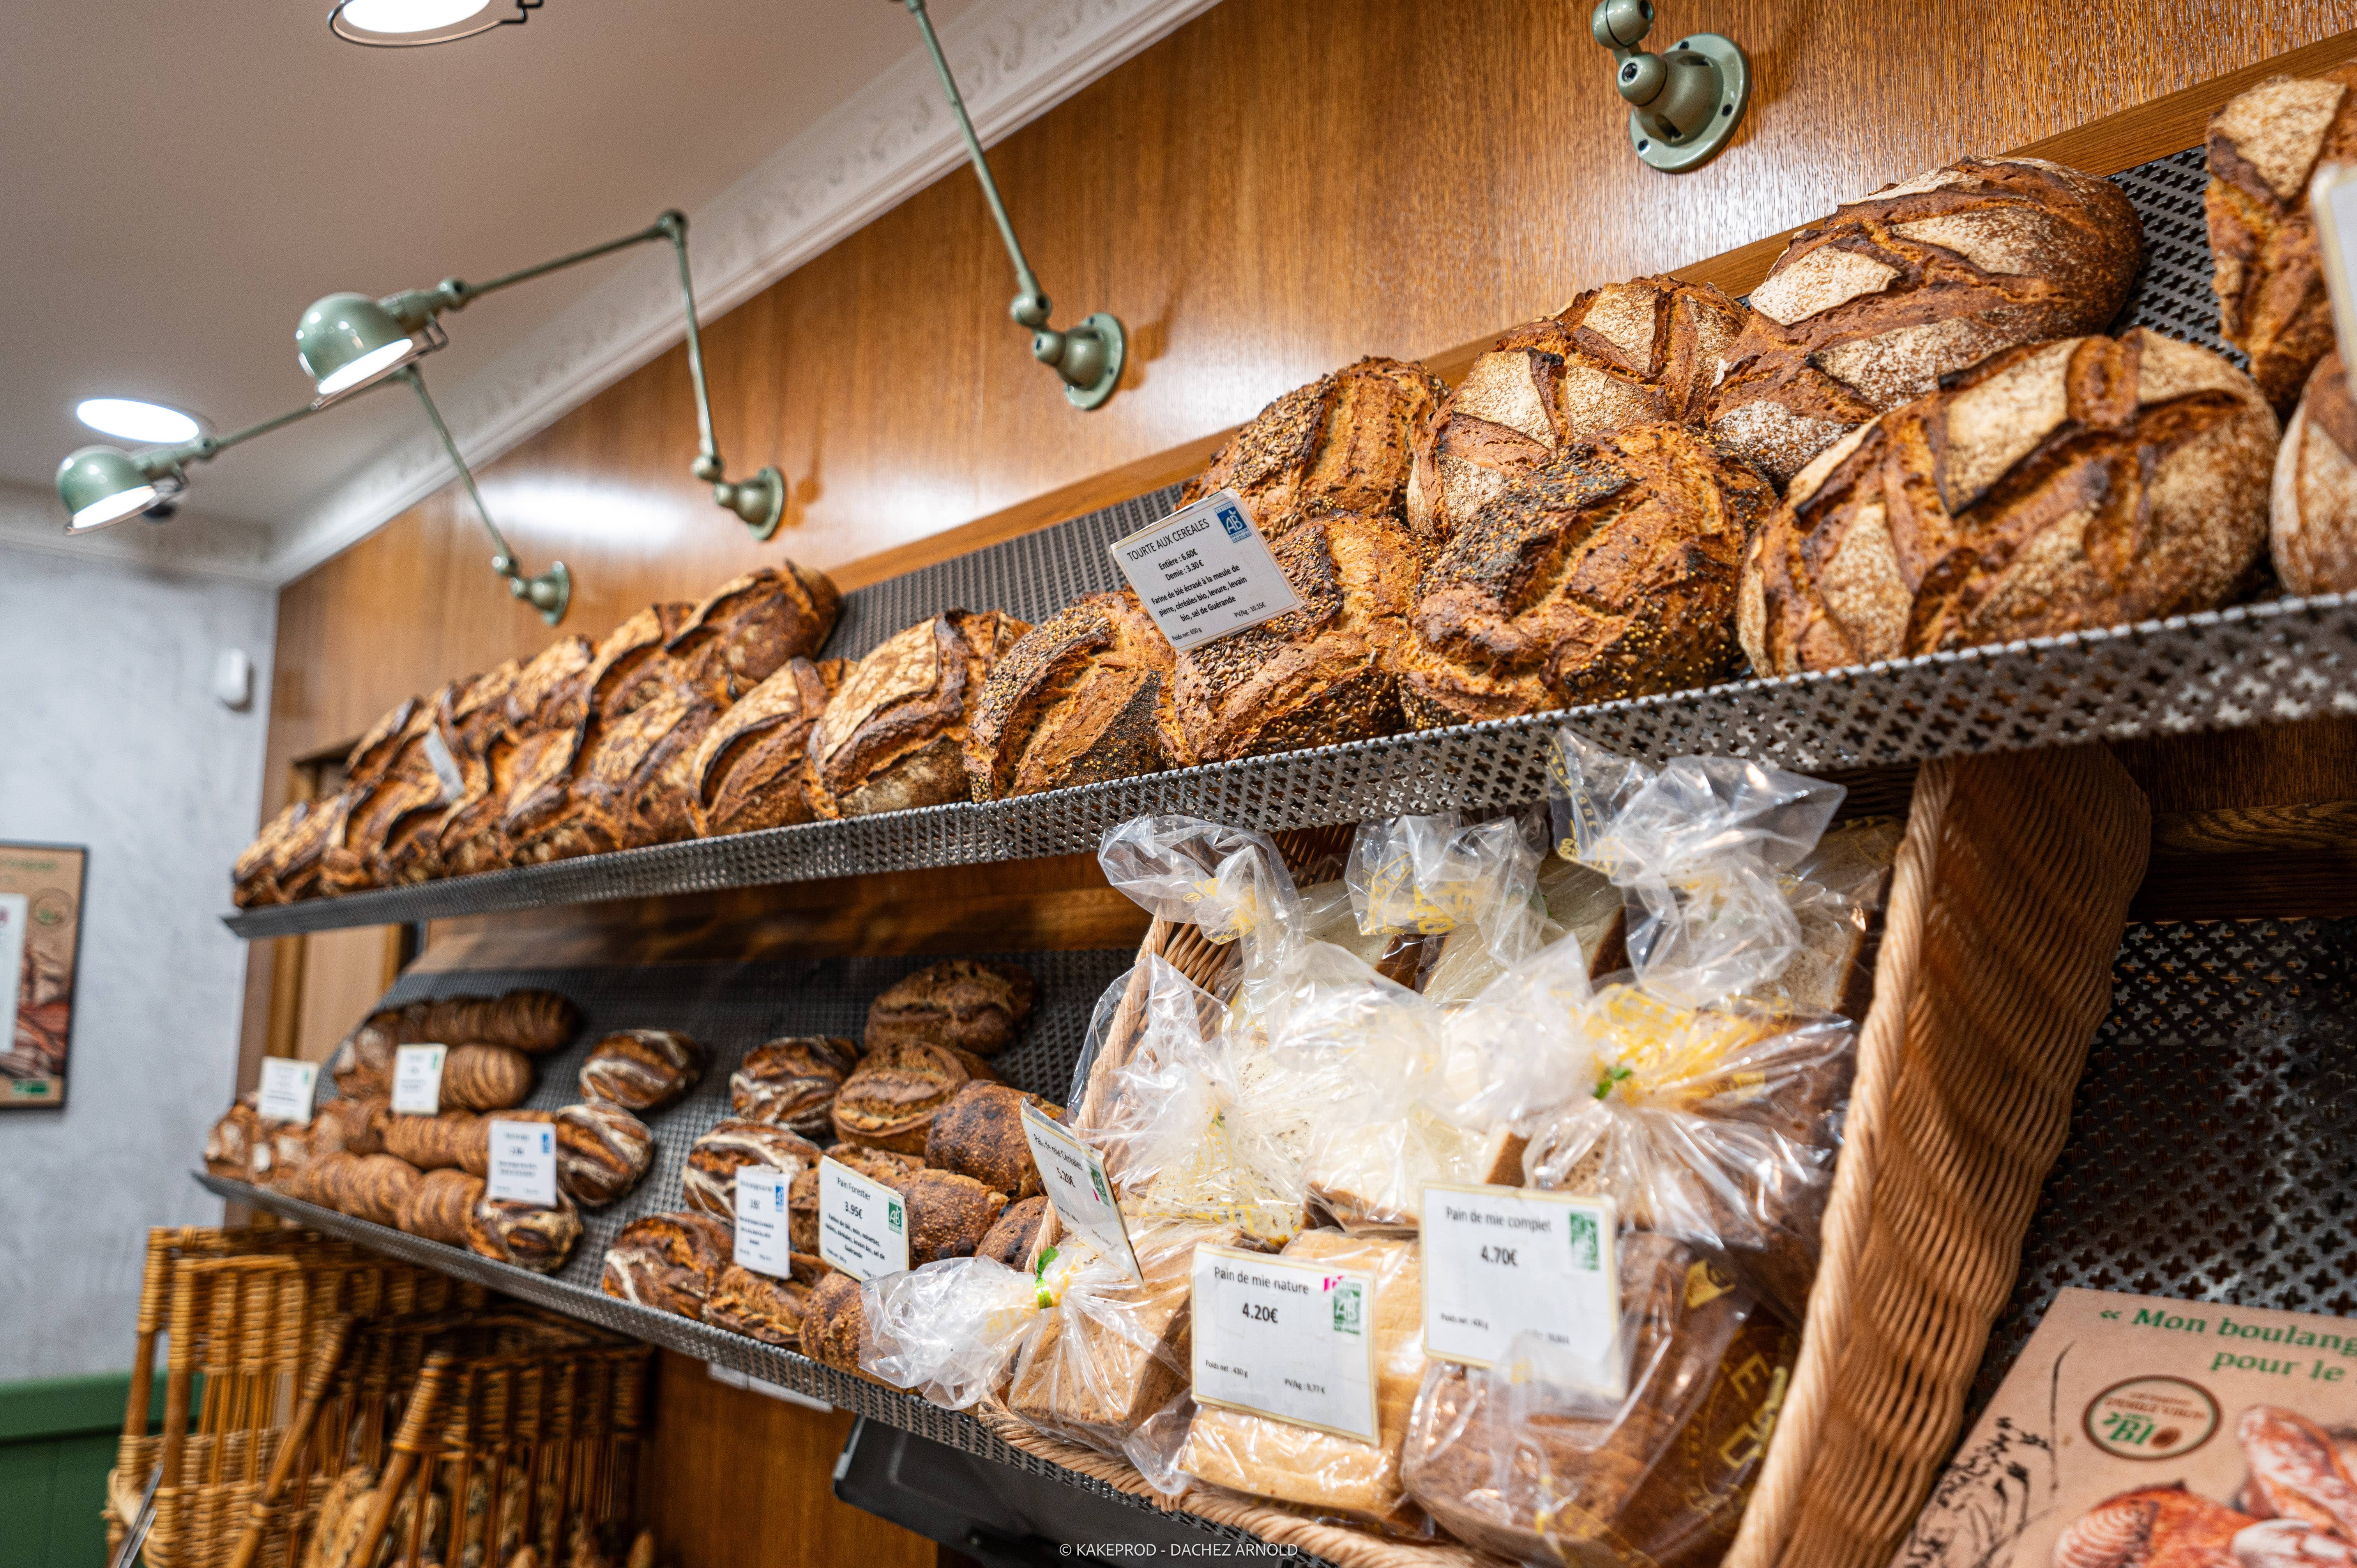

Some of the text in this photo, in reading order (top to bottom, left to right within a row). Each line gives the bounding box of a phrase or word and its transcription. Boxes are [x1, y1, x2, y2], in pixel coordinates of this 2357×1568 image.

[1226, 515, 1243, 534] AB
[1127, 519, 1209, 561] TOURTE AUX CEREALES
[1158, 558, 1178, 570] Entière
[1181, 549, 1198, 560] 6.60€
[1165, 569, 1184, 581] Demie
[1151, 595, 1168, 604] Farine
[1174, 587, 1184, 595] blé
[1184, 579, 1202, 592] écrasé
[1213, 569, 1232, 580] meule
[1159, 607, 1176, 617] pierre,
[1176, 597, 1198, 609] céréales
[1208, 586, 1229, 596] levure,
[1228, 577, 1247, 588] levain
[1192, 609, 1200, 617] sel
[1208, 596, 1236, 611] Guérande
[1250, 602, 1266, 611] 10.15€
[1051, 1146, 1062, 1158] mie
[1061, 1150, 1083, 1171] Céréales
[1057, 1167, 1076, 1188] 5.20€
[837, 1177, 871, 1200] Pain Forestier
[845, 1201, 863, 1219] 3.95€
[890, 1210, 900, 1225] AB
[1446, 1206, 1467, 1221] Pain
[1470, 1211, 1482, 1224] de
[1507, 1217, 1551, 1233] complet
[1481, 1246, 1517, 1266] 4.70€
[1215, 1267, 1309, 1295] Pain de mie nature
[1242, 1303, 1278, 1324] 4.20€
[2131, 1308, 2207, 1333] Mon
[1206, 1360, 1219, 1370] Poids
[2210, 1352, 2345, 1381] pour le
